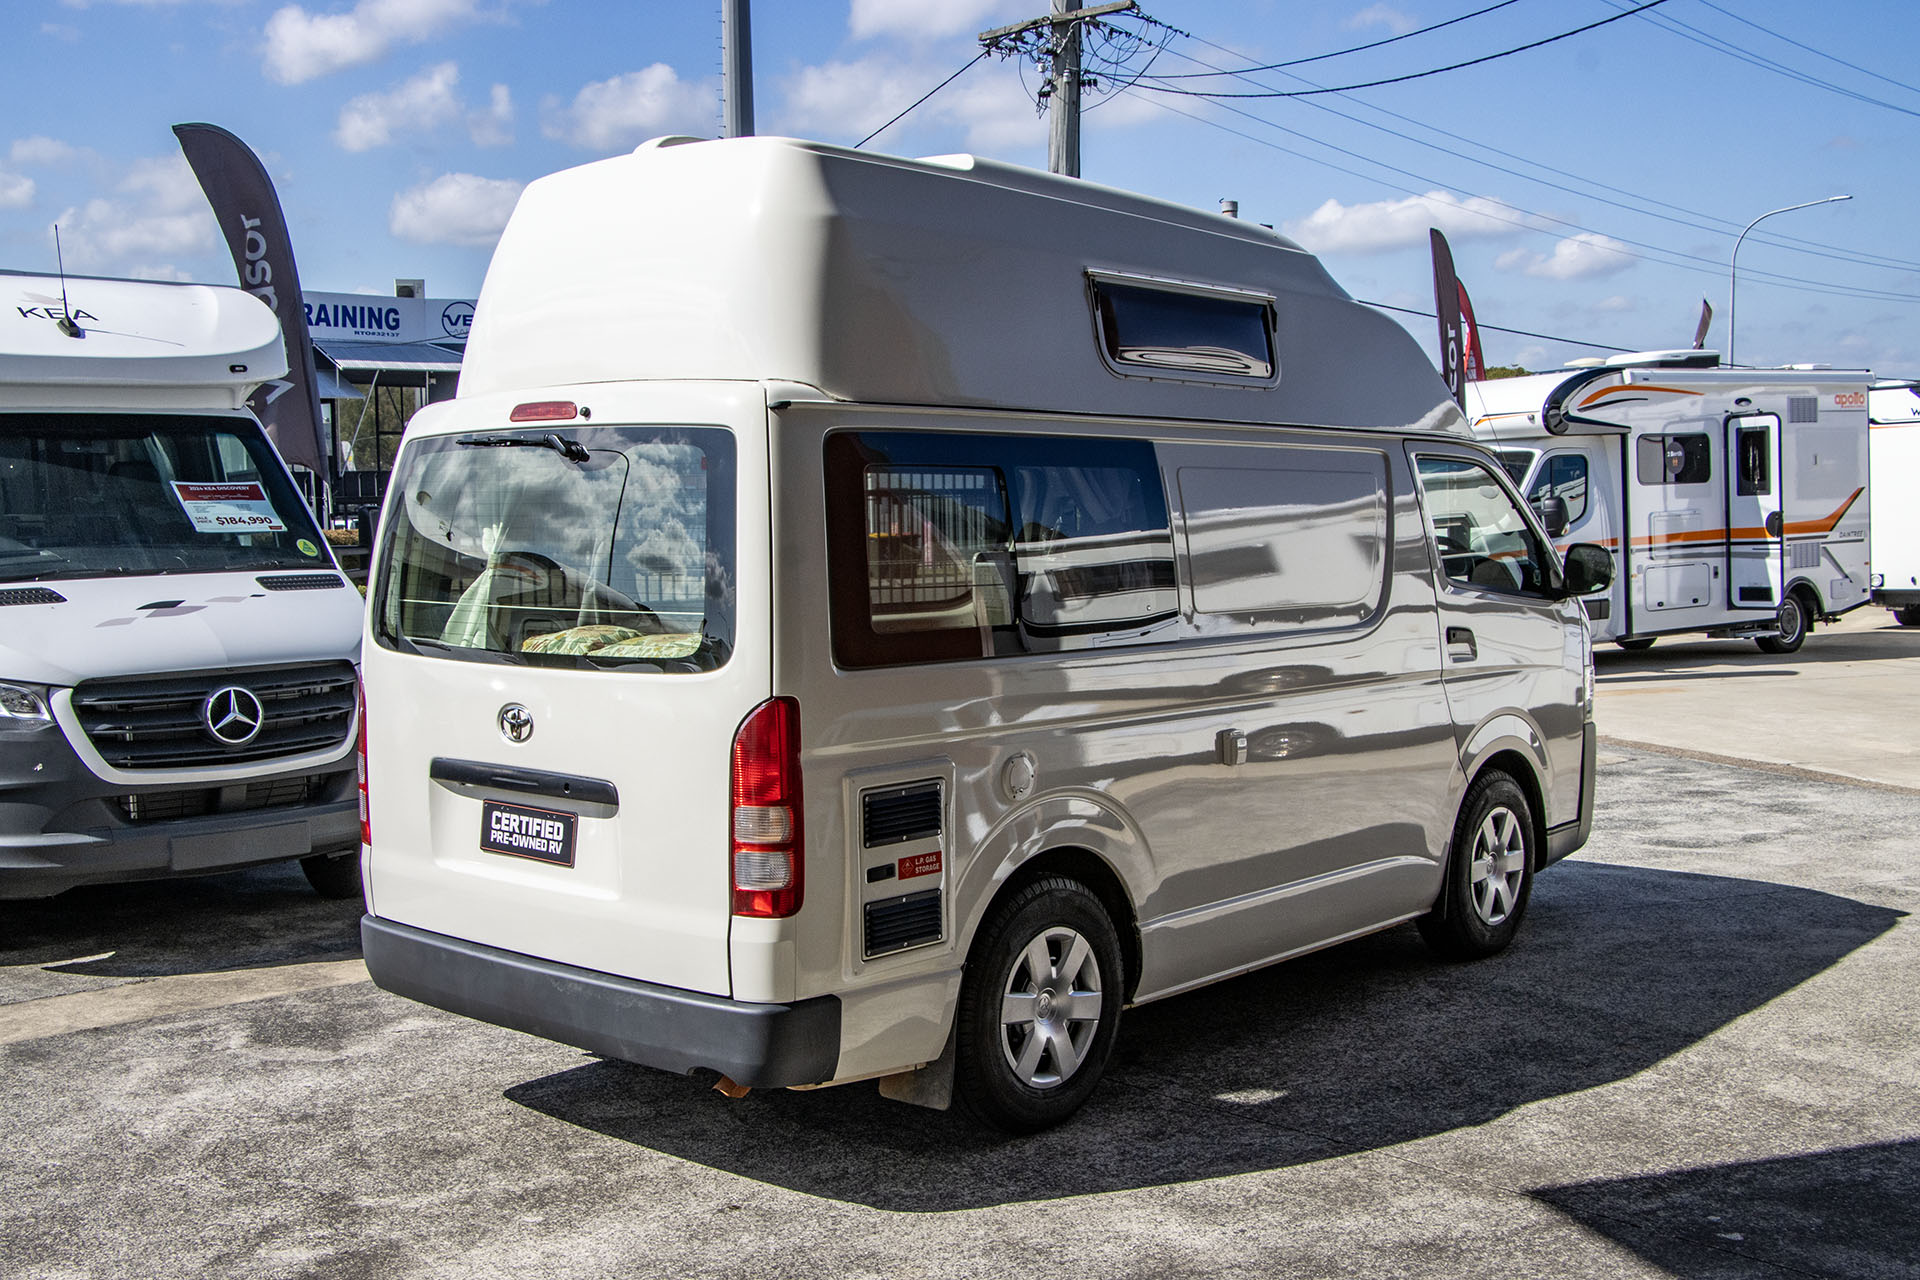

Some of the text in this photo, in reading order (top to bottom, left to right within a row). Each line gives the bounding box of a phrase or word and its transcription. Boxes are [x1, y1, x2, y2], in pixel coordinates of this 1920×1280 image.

[16, 306, 100, 321] KEA
[303, 303, 400, 331] RAINING
[1834, 391, 1865, 405] apollo
[215, 516, 273, 526] $184,990
[491, 810, 564, 841] CERTIFIED
[490, 829, 563, 855] PRE-OWNED RV
[925, 855, 937, 864] GAS
[915, 862, 940, 874] STORAGE
